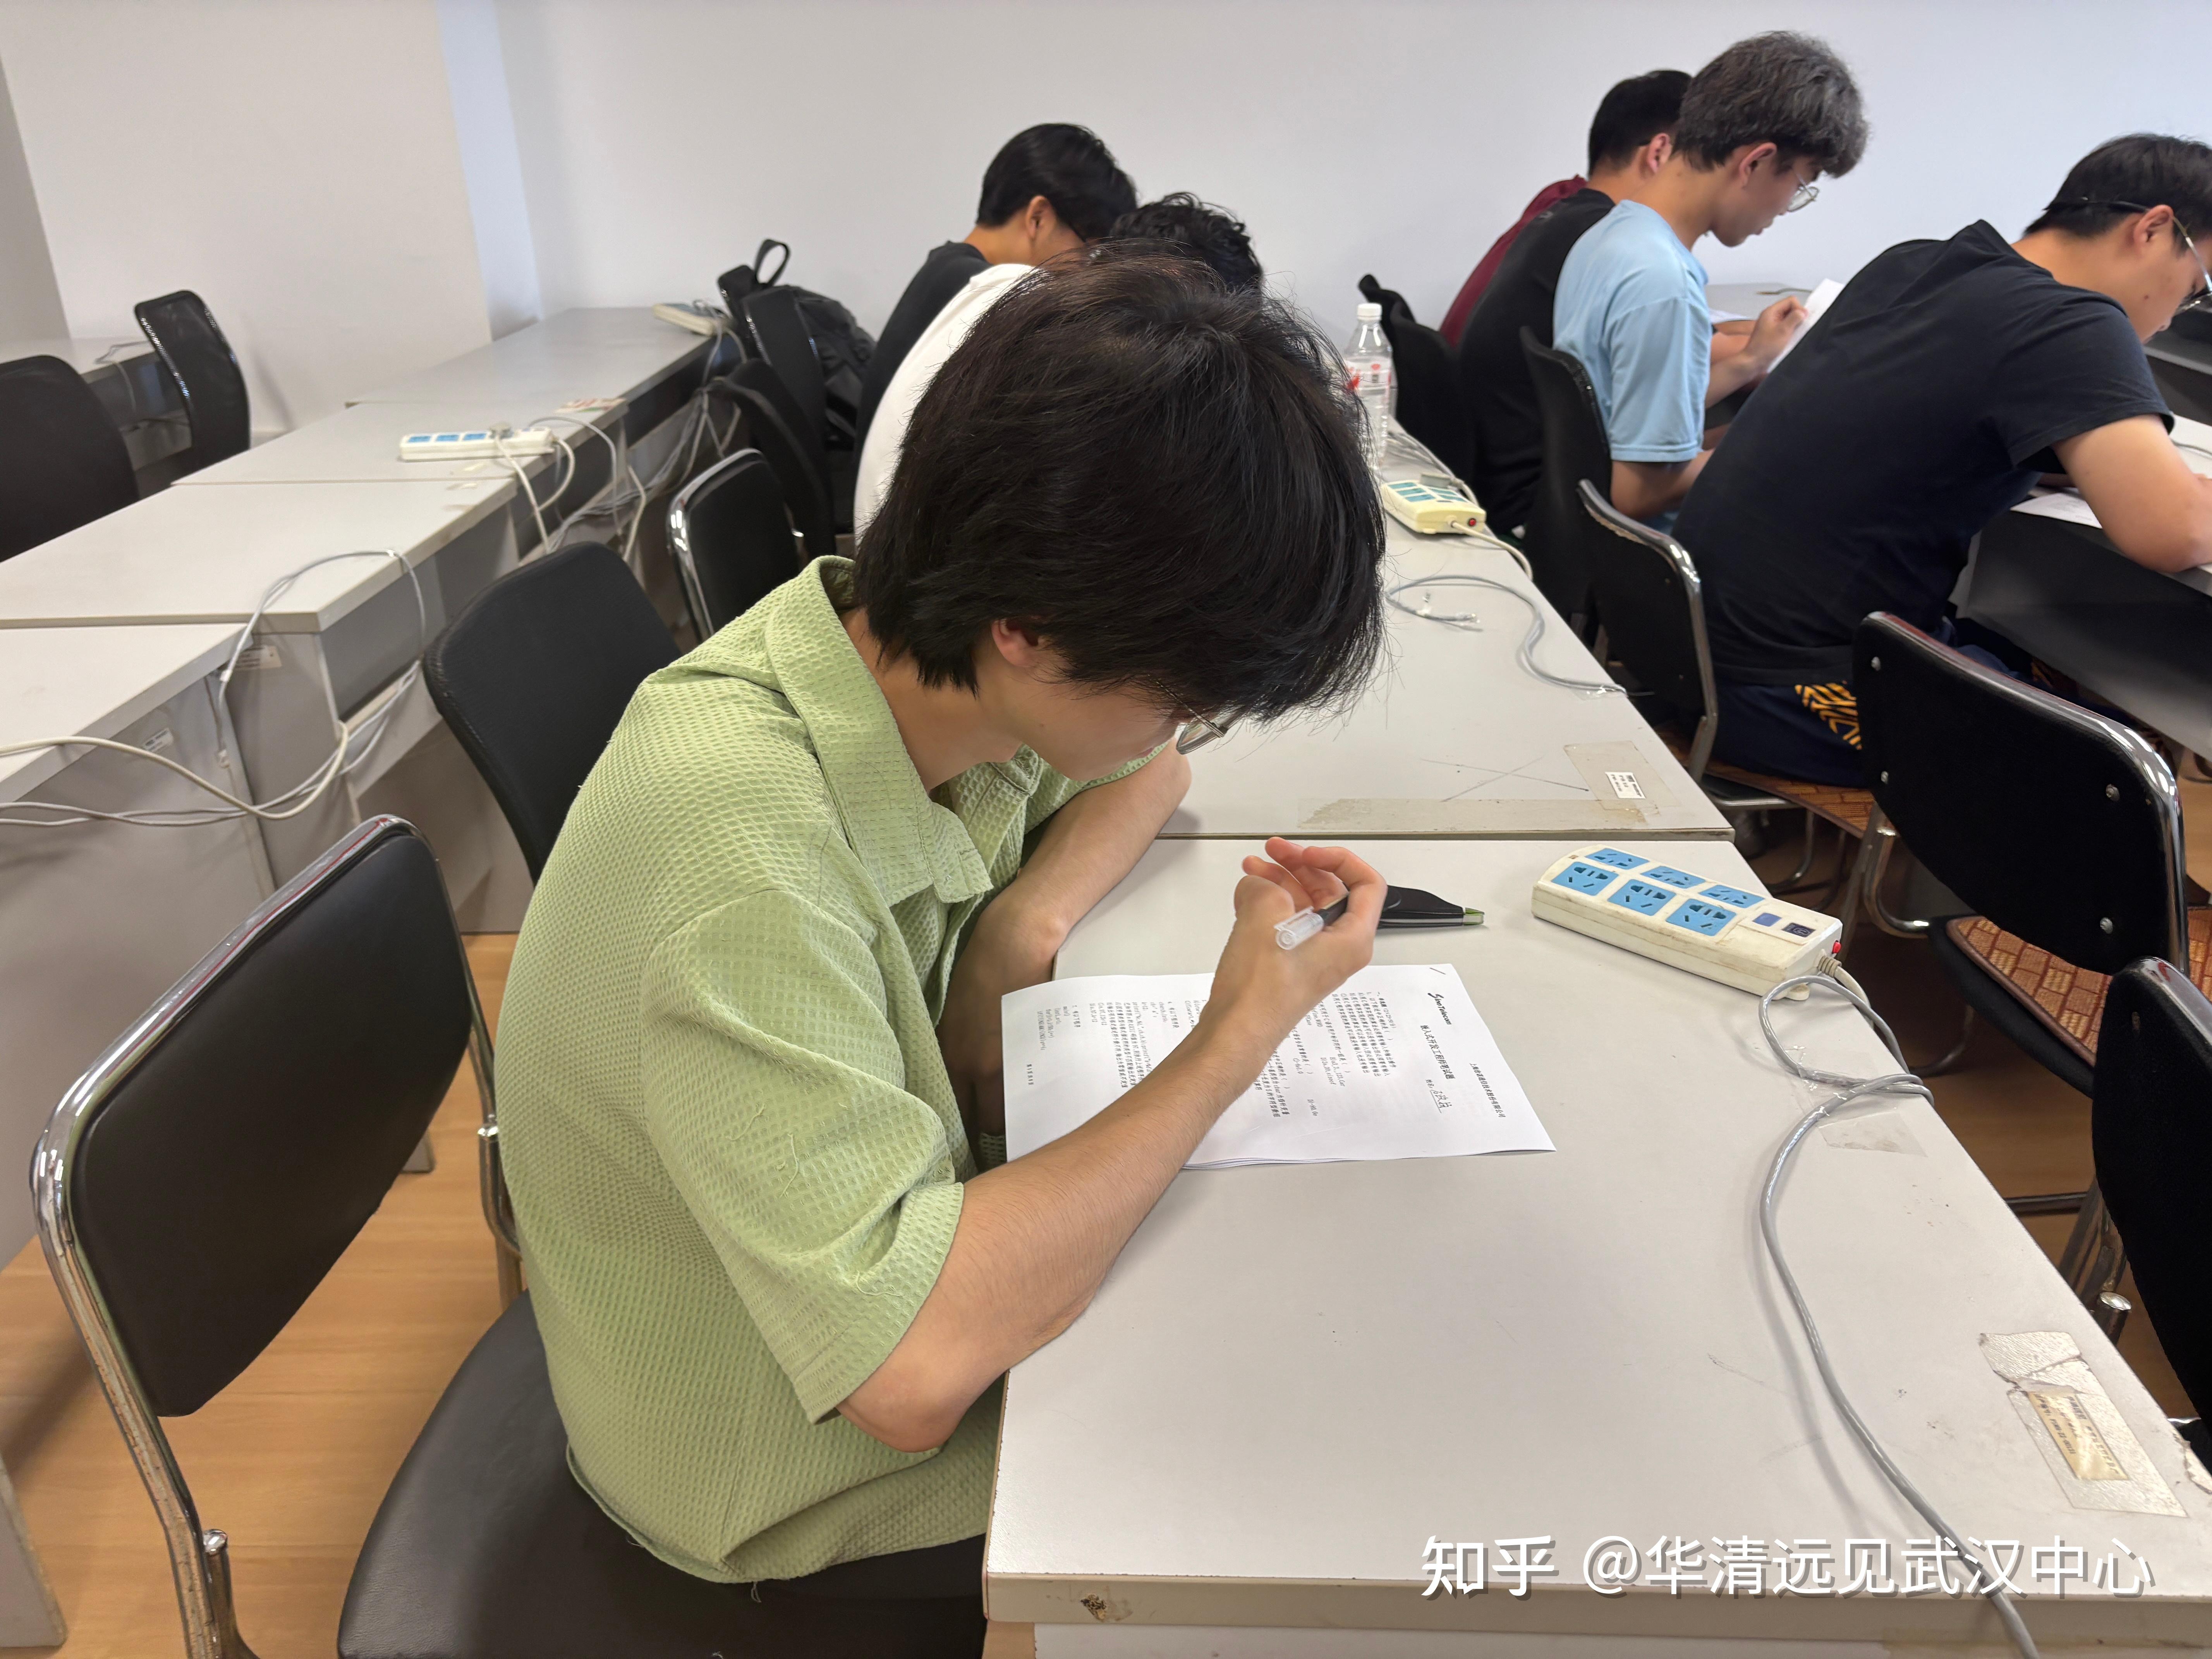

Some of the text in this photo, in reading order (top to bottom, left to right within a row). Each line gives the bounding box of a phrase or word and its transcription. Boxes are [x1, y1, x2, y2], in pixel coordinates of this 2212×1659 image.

[1420, 1025, 1456, 1080] 嵌入式开发工程师笔试题
